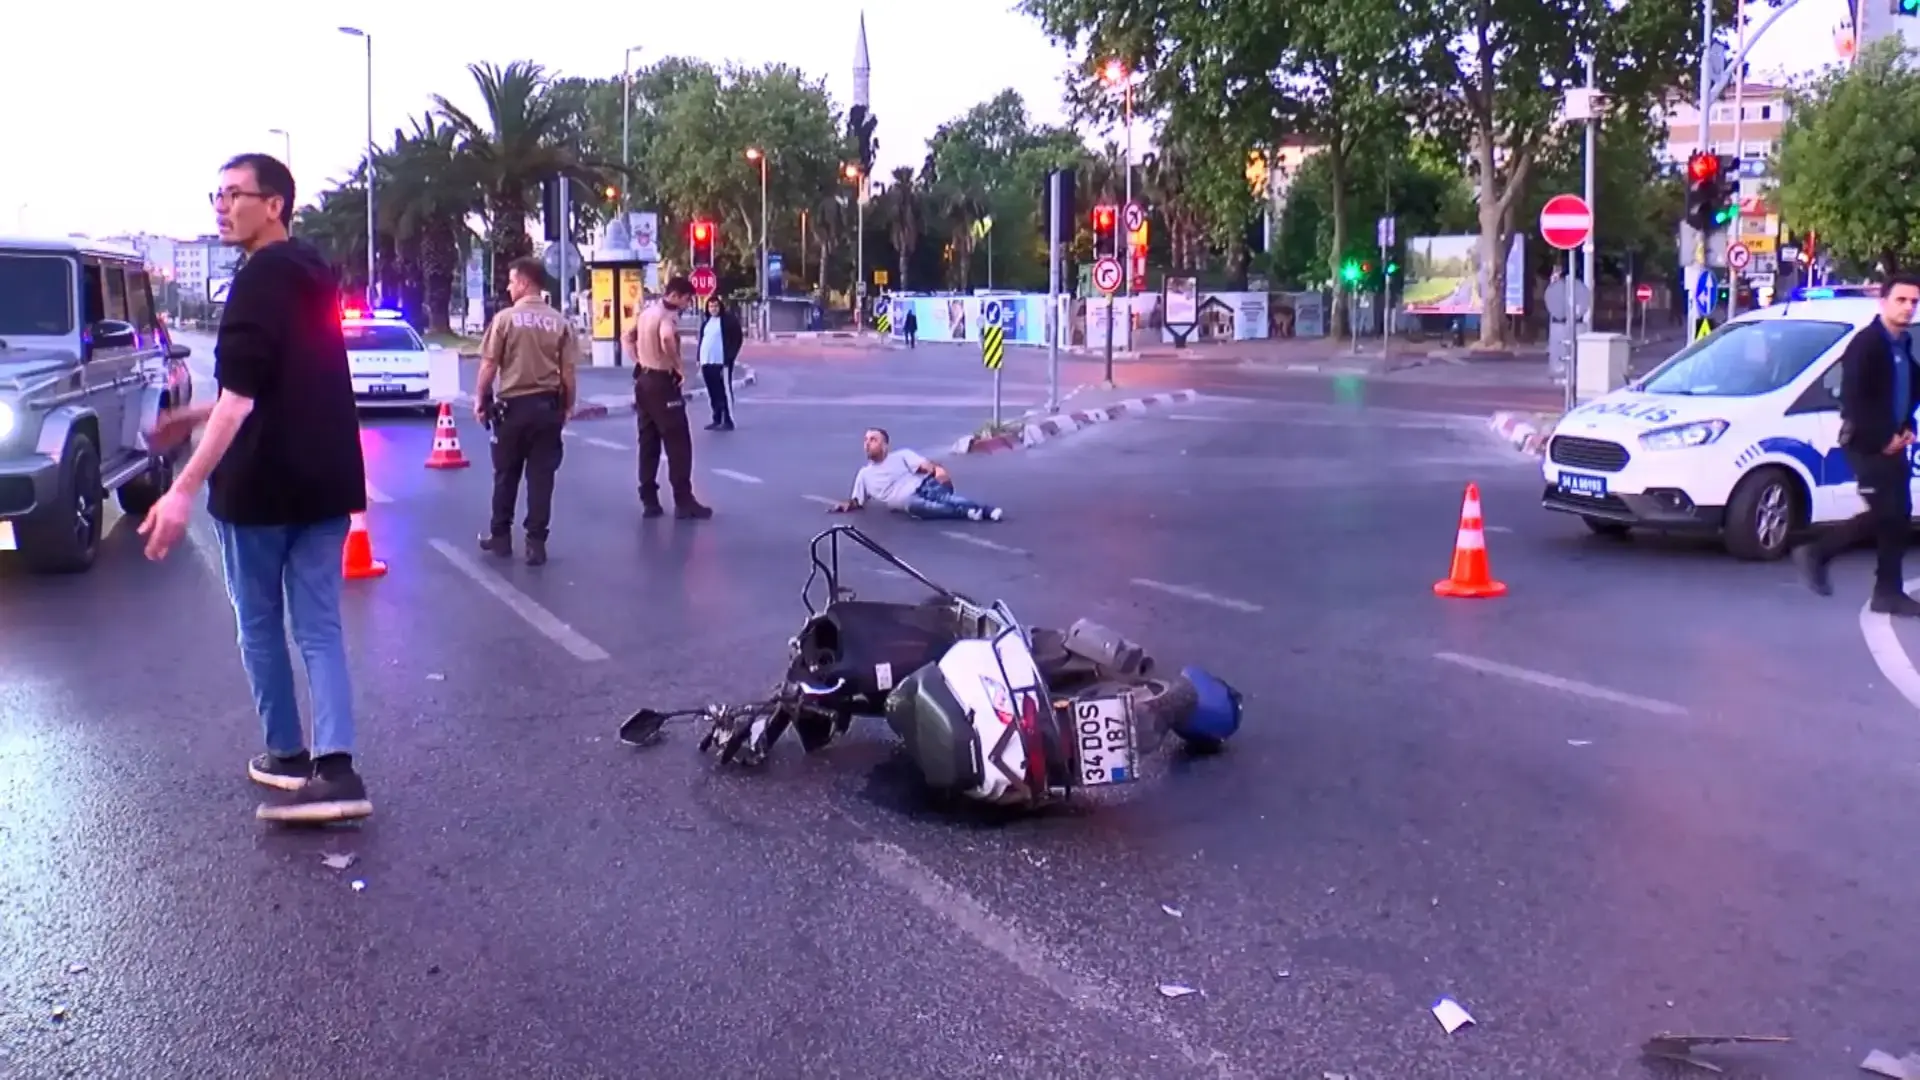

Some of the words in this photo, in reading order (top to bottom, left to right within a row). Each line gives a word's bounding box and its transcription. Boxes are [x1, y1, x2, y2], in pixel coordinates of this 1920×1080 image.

[1079, 704, 1103, 751] DOS
[1104, 717, 1128, 753] 187
[1084, 755, 1105, 780] 34
